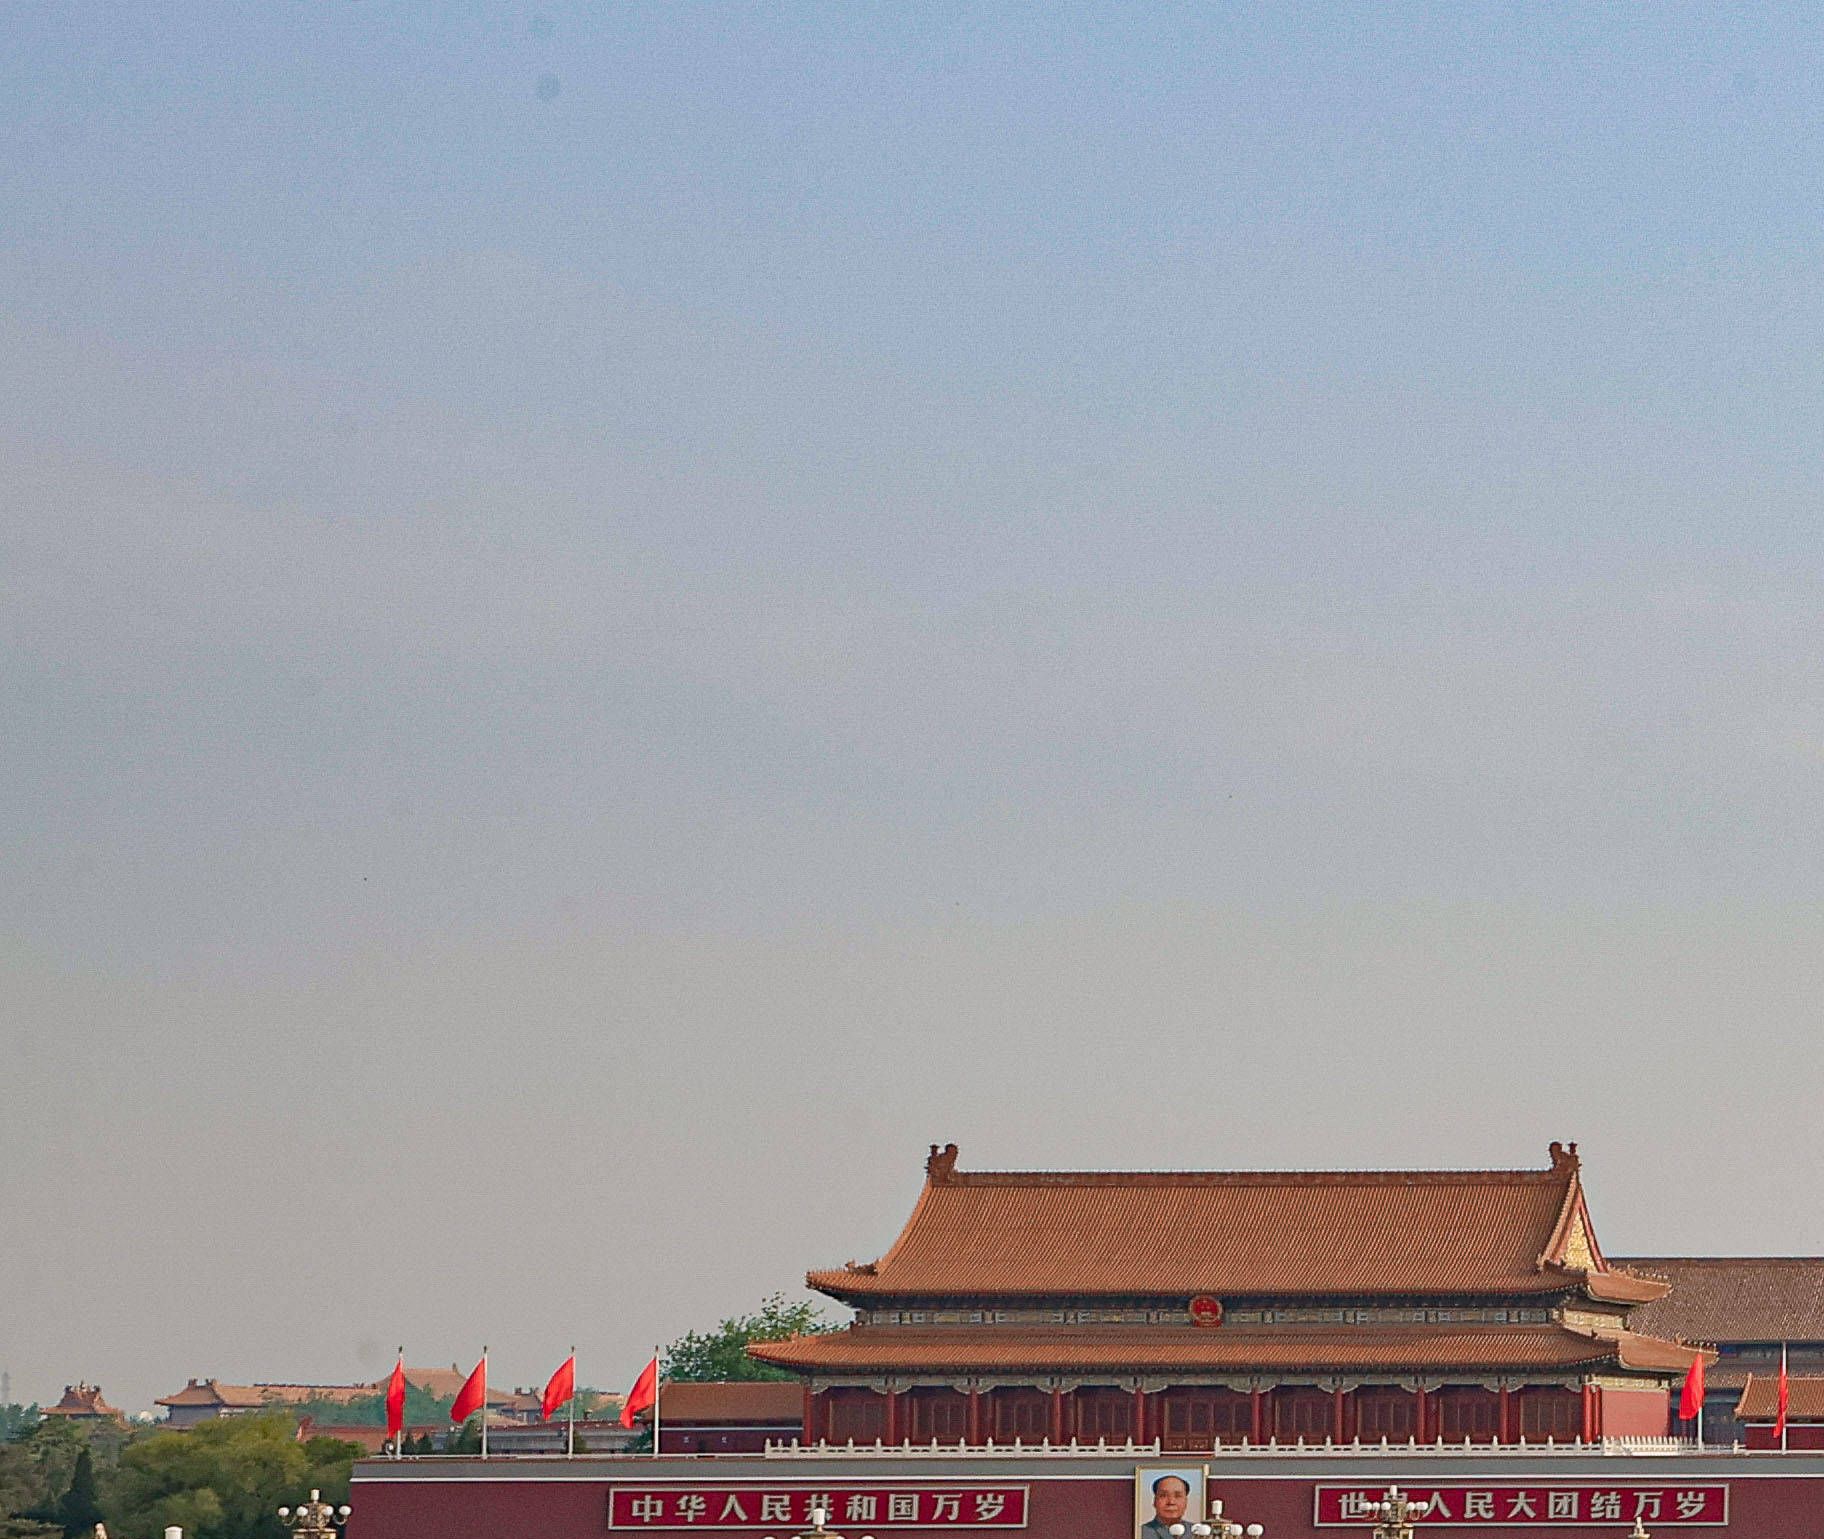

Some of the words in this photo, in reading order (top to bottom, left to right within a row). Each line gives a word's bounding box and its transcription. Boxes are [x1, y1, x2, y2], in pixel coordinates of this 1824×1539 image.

[631, 1492, 1006, 1523] 中华人民共和国万岁
